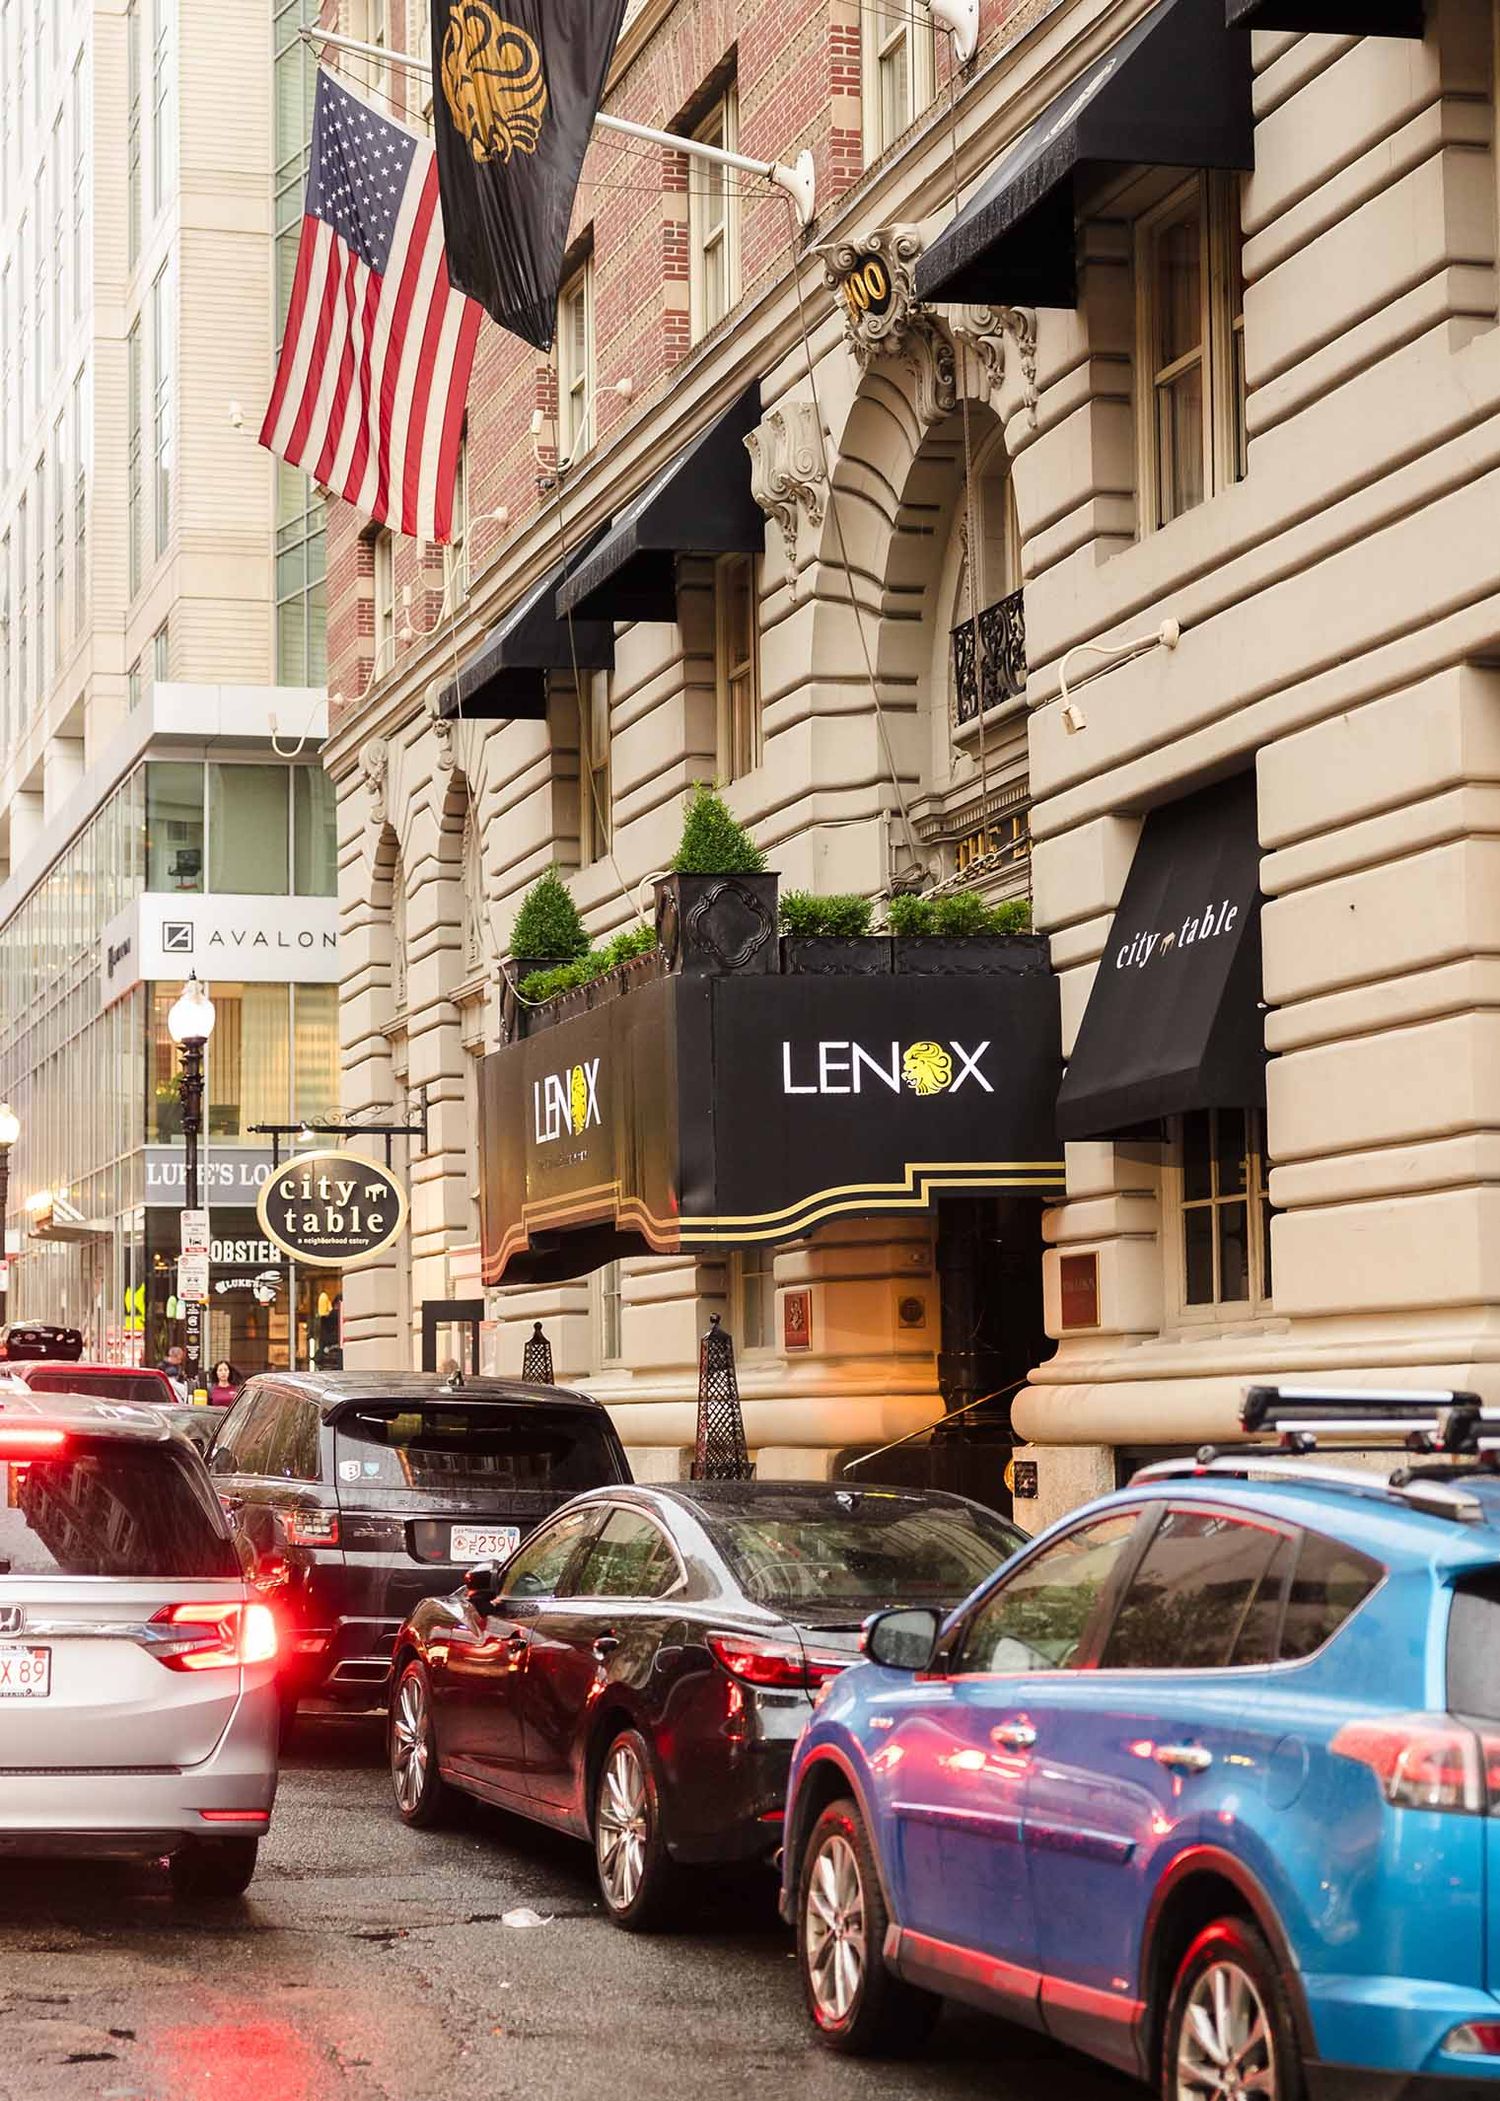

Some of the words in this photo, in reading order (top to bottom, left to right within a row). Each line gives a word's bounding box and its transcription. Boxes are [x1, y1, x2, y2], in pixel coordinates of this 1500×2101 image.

[209, 930, 337, 948] AVALON
[1116, 931, 1160, 969] city
[1178, 899, 1238, 947] table
[279, 1173, 357, 1206] city
[284, 1206, 384, 1233] table
[210, 1240, 282, 1263] OBSTER
[303, 1237, 348, 1246] neighborhood
[1, 1660, 12, 1685] X
[20, 1660, 45, 1684] 89
